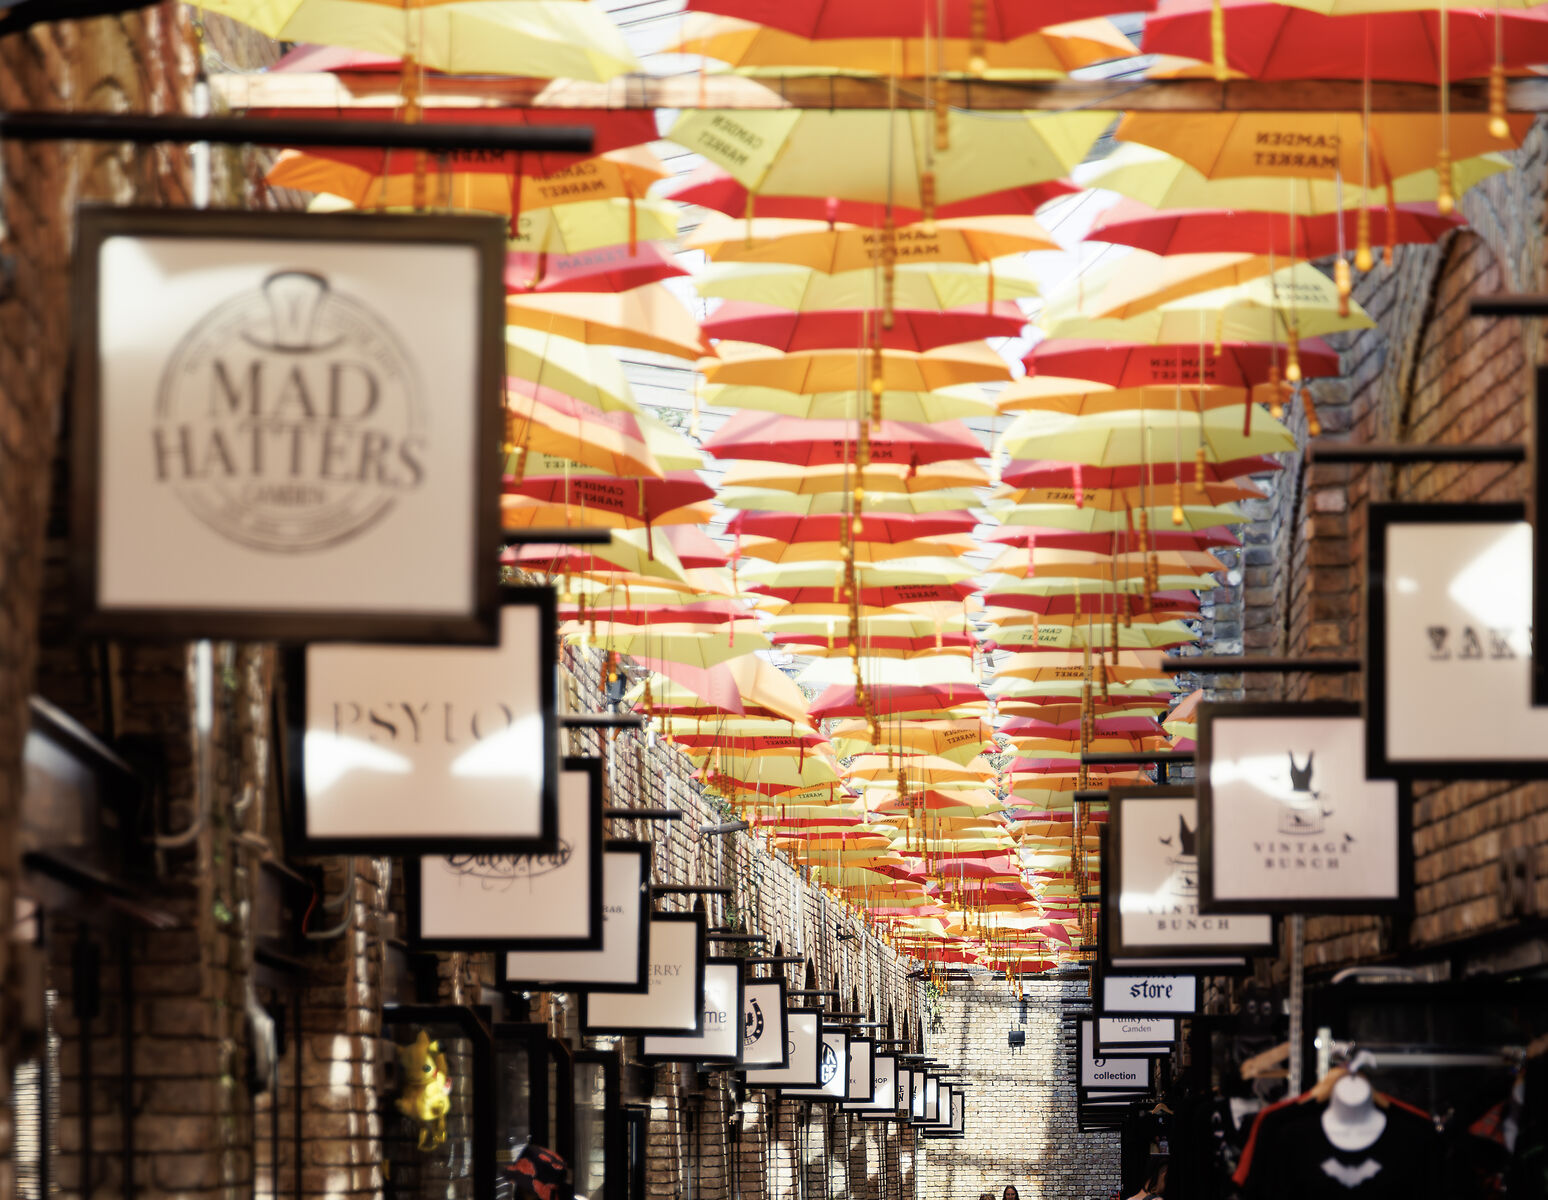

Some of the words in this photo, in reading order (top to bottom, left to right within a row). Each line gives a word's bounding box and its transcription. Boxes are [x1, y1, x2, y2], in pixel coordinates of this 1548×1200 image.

[208, 357, 382, 421] MAD
[152, 425, 426, 492] HATTERS
[1253, 841, 1352, 854] VINTAGE
[1264, 858, 1339, 869] BUNCH
[1157, 919, 1230, 930] BUNCH
[1130, 980, 1173, 998] store
[1121, 1025, 1152, 1033] Camden
[1093, 1071, 1136, 1080] collection
